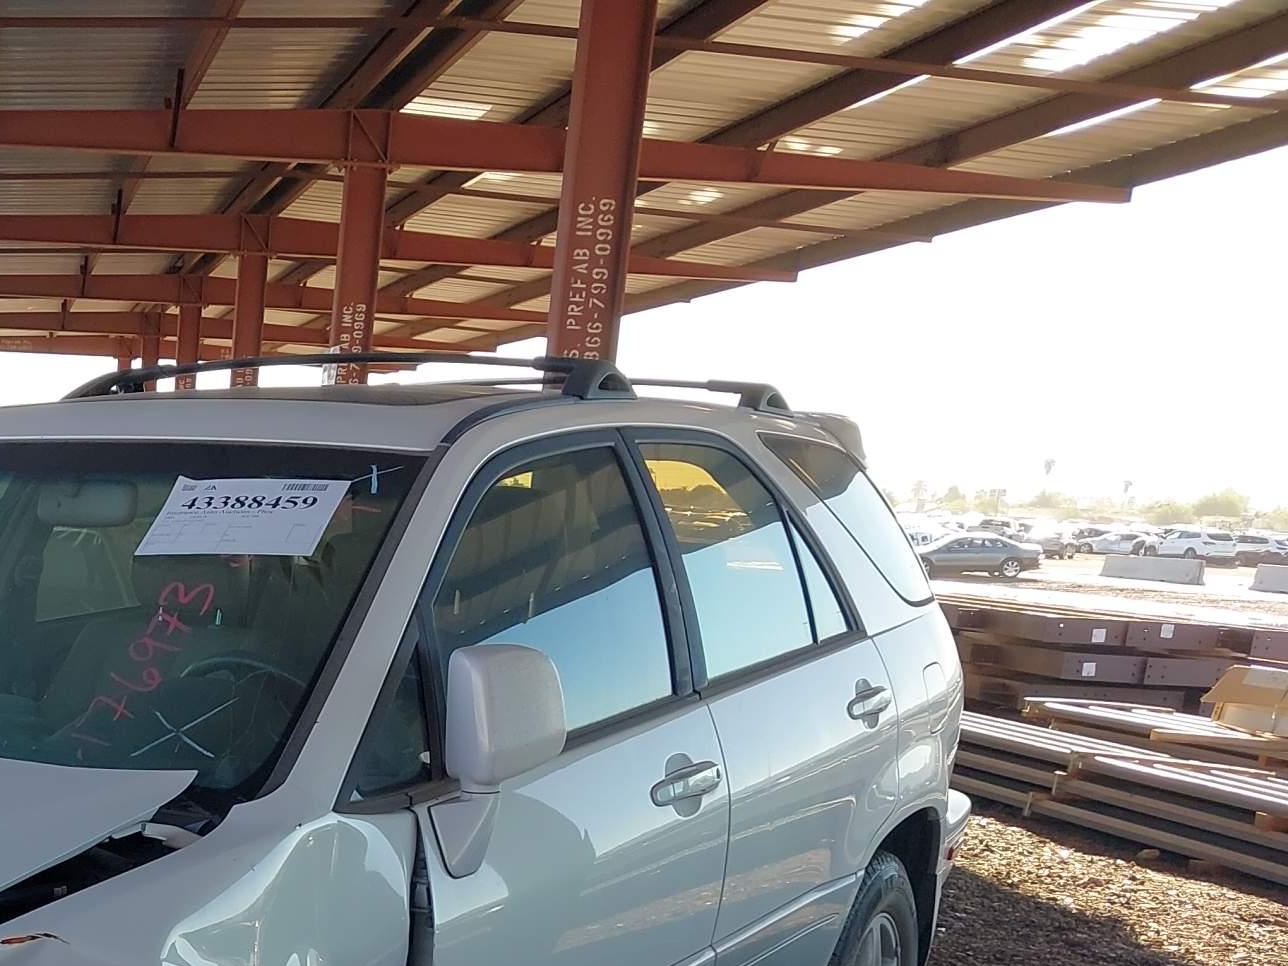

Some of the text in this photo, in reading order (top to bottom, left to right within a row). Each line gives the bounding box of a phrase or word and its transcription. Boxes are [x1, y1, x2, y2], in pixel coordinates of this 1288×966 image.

[575, 195, 597, 236] INC.
[566, 248, 590, 330] PREFAB
[336, 301, 354, 384] PRAB INC.
[181, 495, 318, 510] 43388459
